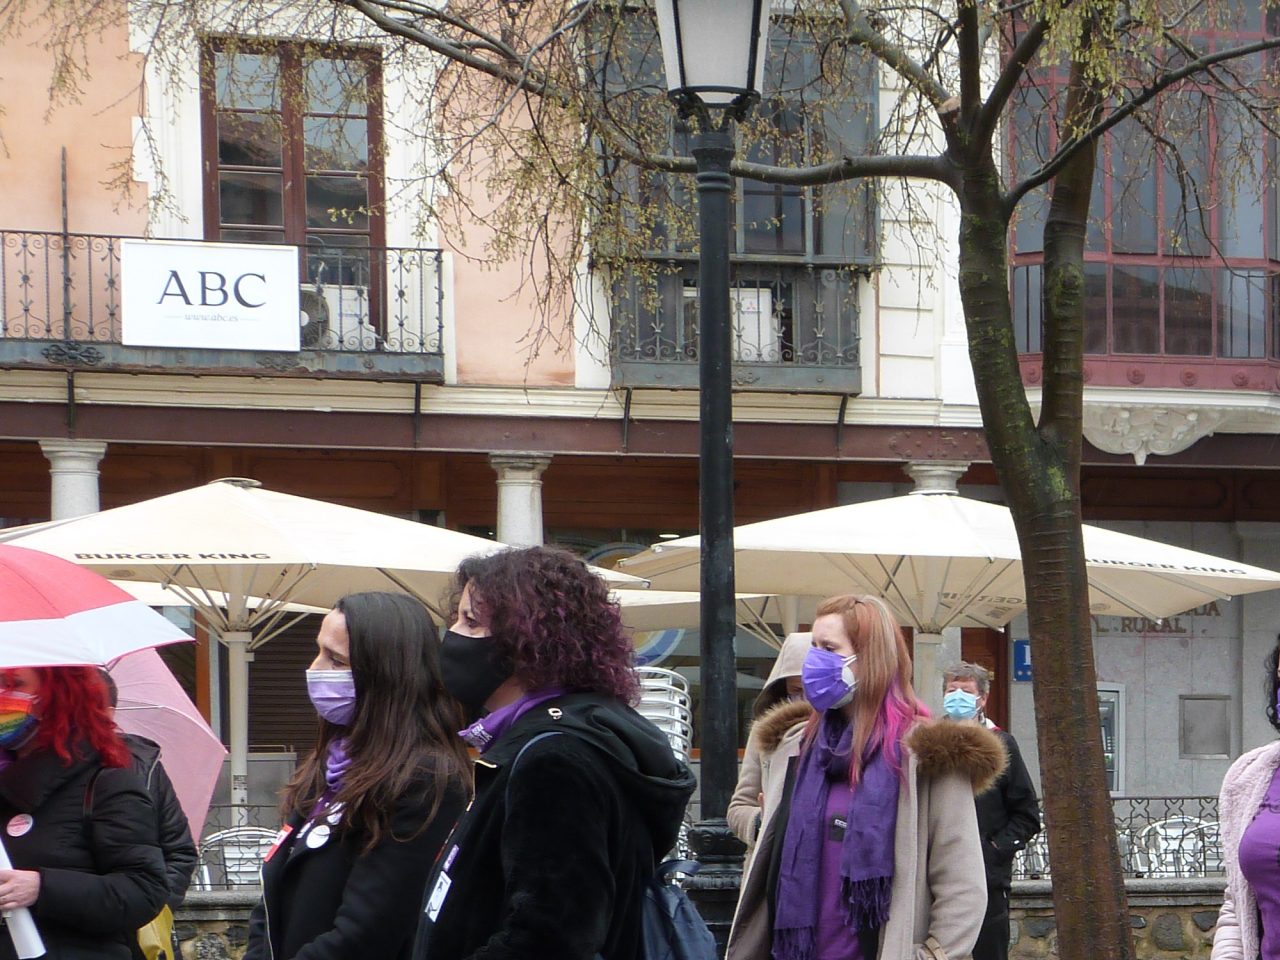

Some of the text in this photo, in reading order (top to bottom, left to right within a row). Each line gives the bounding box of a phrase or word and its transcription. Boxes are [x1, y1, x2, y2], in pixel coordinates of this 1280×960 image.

[156, 270, 267, 309] ABC
[184, 312, 239, 323] www.abc.es
[74, 552, 272, 560] BURGER KING
[1184, 565, 1248, 575] KING
